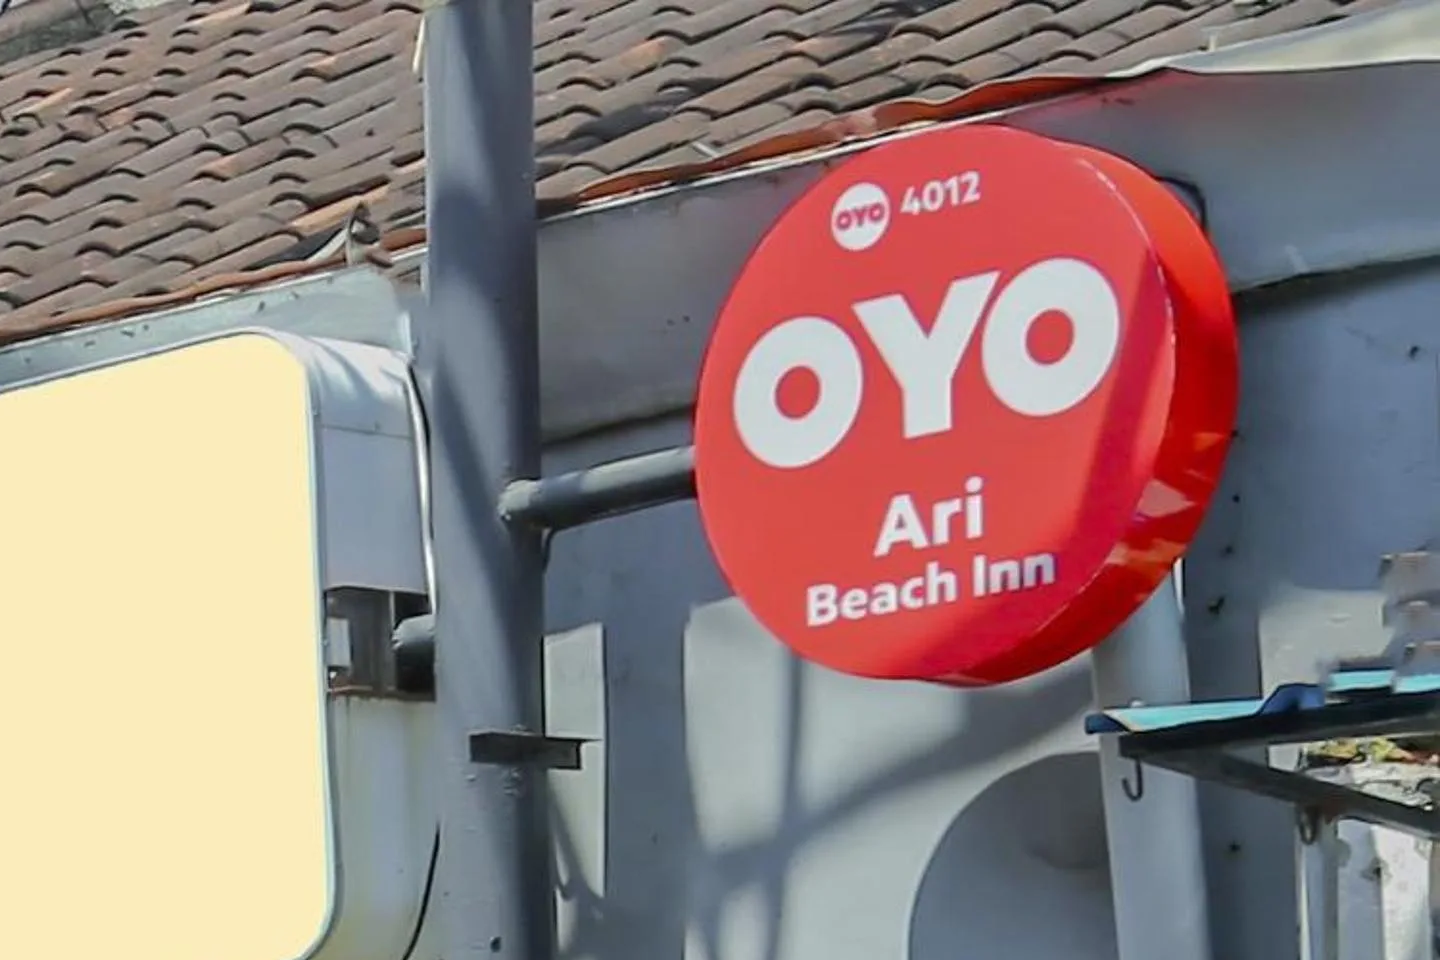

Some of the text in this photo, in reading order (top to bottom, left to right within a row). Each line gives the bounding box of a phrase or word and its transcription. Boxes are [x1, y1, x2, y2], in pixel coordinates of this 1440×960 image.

[837, 171, 981, 230] OYO 4012
[733, 257, 1120, 468] OYO
[874, 476, 985, 557] Ari
[806, 552, 1055, 627] Beach Inn
